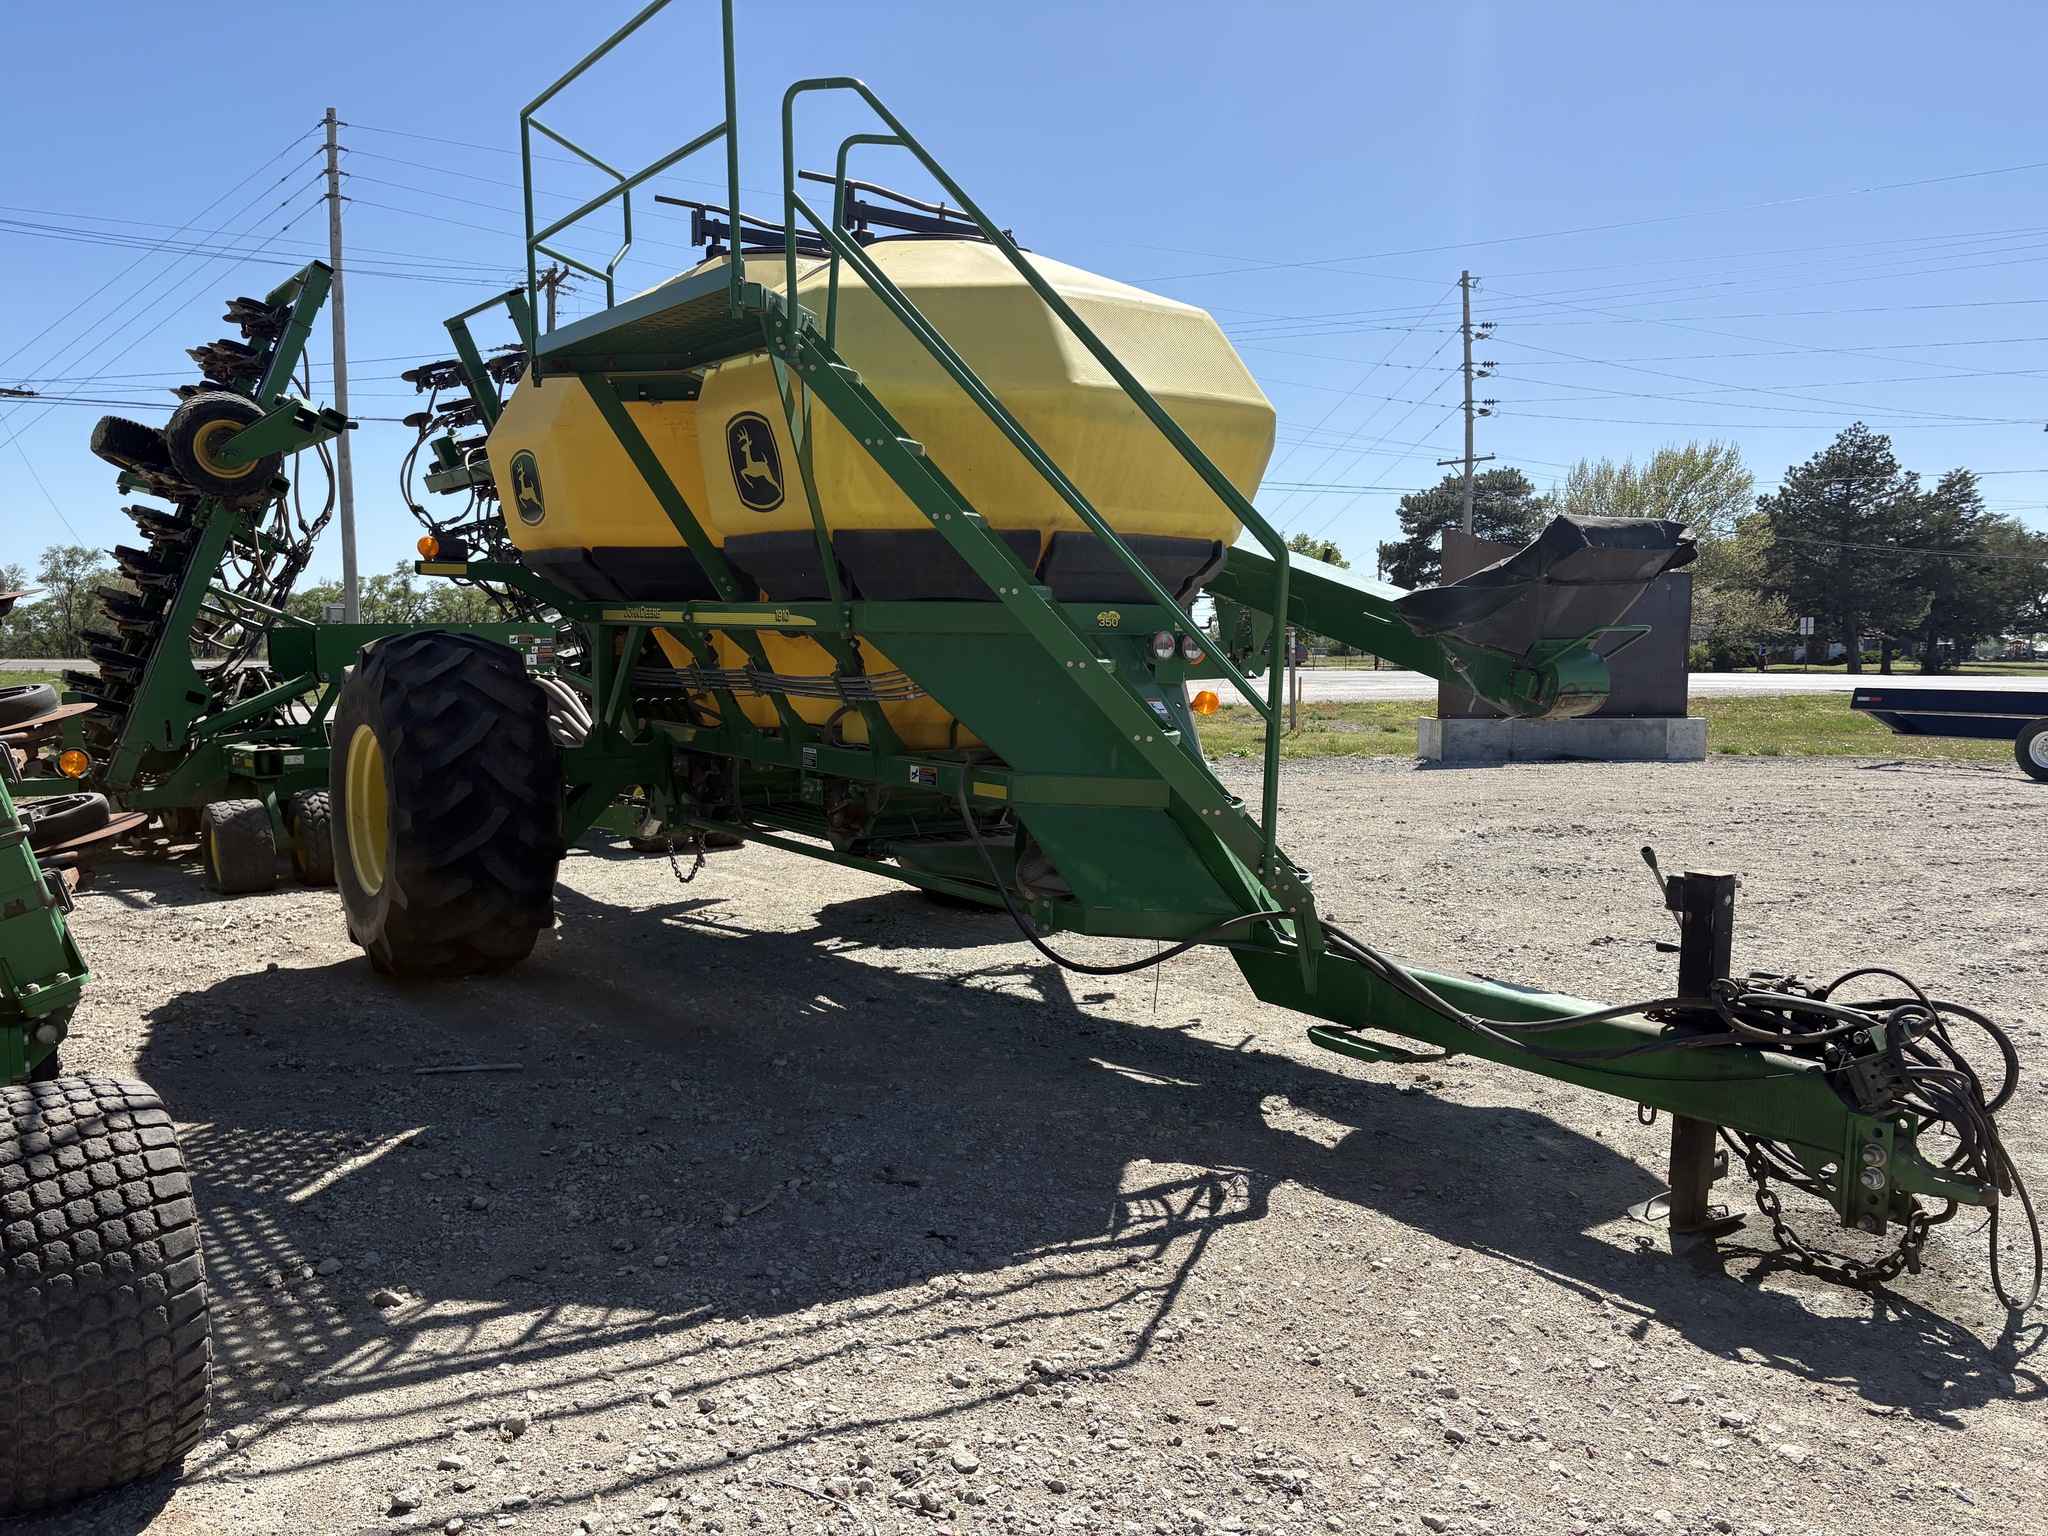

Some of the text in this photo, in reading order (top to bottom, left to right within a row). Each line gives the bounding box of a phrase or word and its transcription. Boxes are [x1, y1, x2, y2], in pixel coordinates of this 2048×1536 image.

[624, 605, 661, 619] JOHN DEERE
[775, 609, 790, 622] 1910
[1098, 618, 1119, 628] 350
